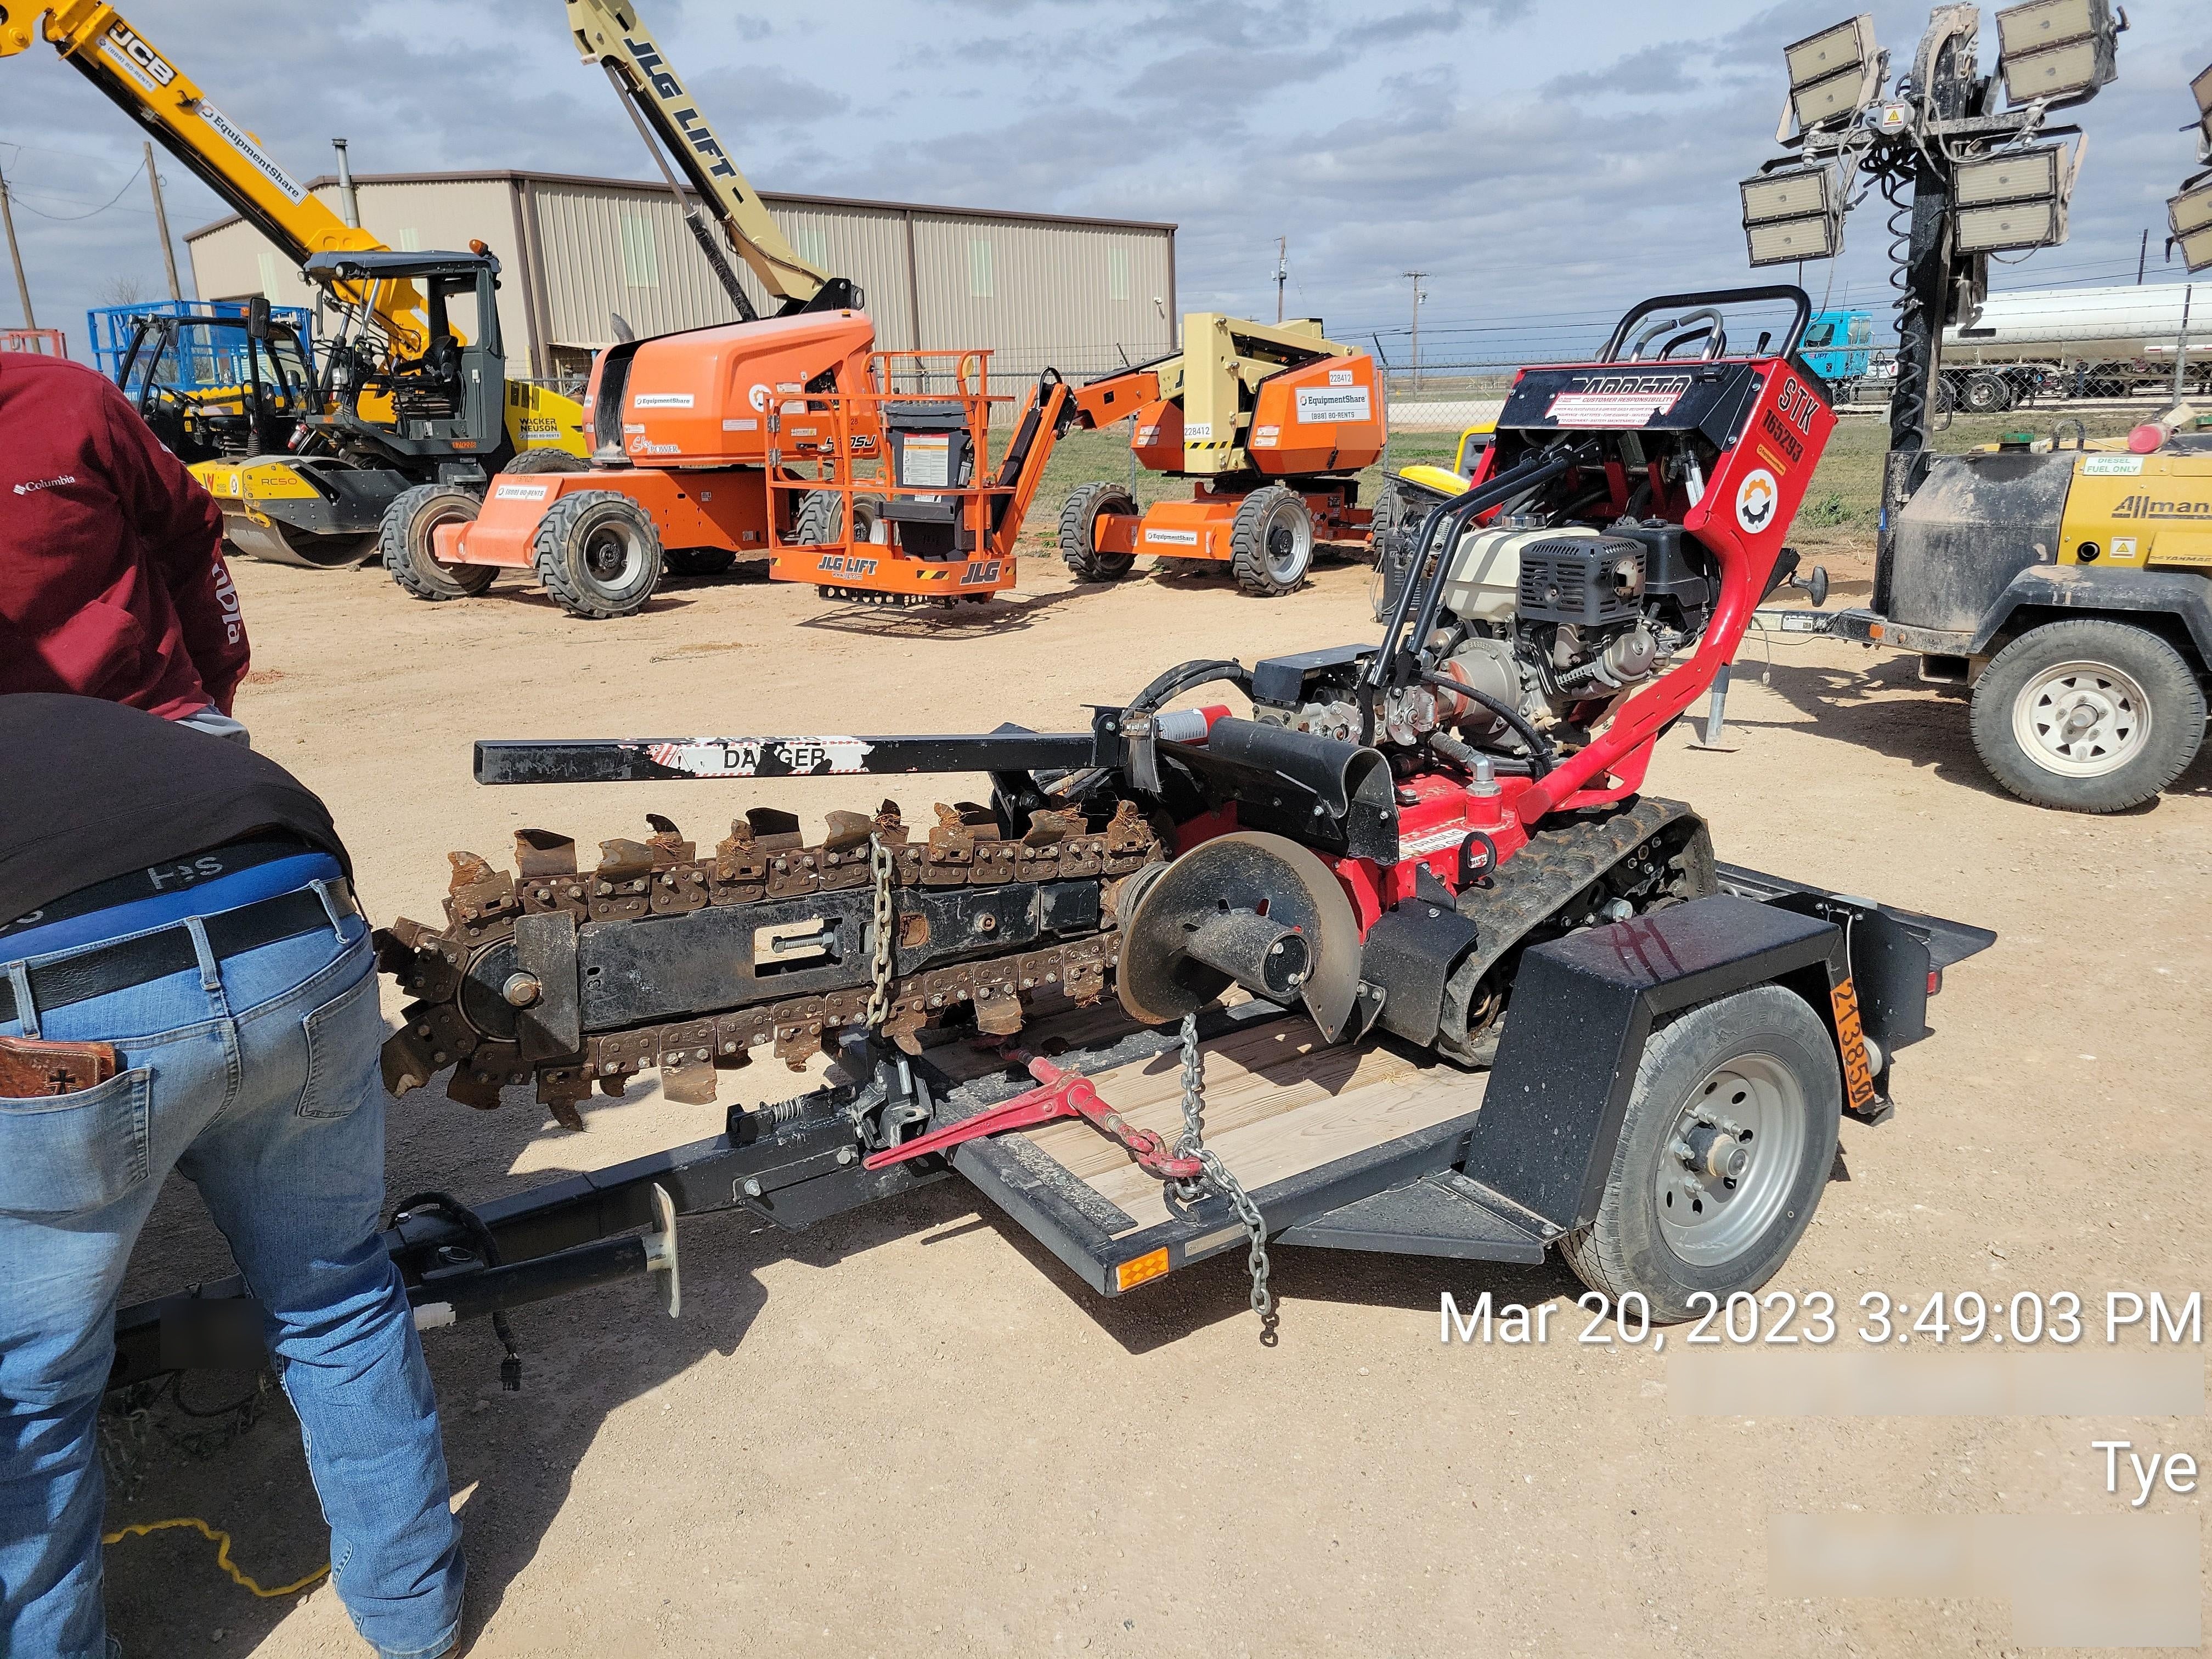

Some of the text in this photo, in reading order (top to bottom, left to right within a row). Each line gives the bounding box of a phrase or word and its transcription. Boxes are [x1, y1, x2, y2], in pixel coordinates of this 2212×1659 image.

[109, 28, 174, 84] JCB
[622, 37, 737, 178] JLG LIFT
[213, 116, 300, 198] EquipmentShare
[1330, 374, 1351, 383] 228412
[1308, 395, 1365, 405] EquipmentShare
[1778, 377, 1820, 436] STK
[1184, 426, 1210, 436] 228412
[1762, 409, 1804, 463] 165293
[25, 475, 75, 492] Columbia
[2113, 496, 2212, 518] Allman
[1153, 533, 1194, 541] EquipmentShare
[817, 555, 878, 575] JLG LIFT
[960, 560, 1002, 585] JLG
[1406, 831, 1464, 849] YDRAULIC
